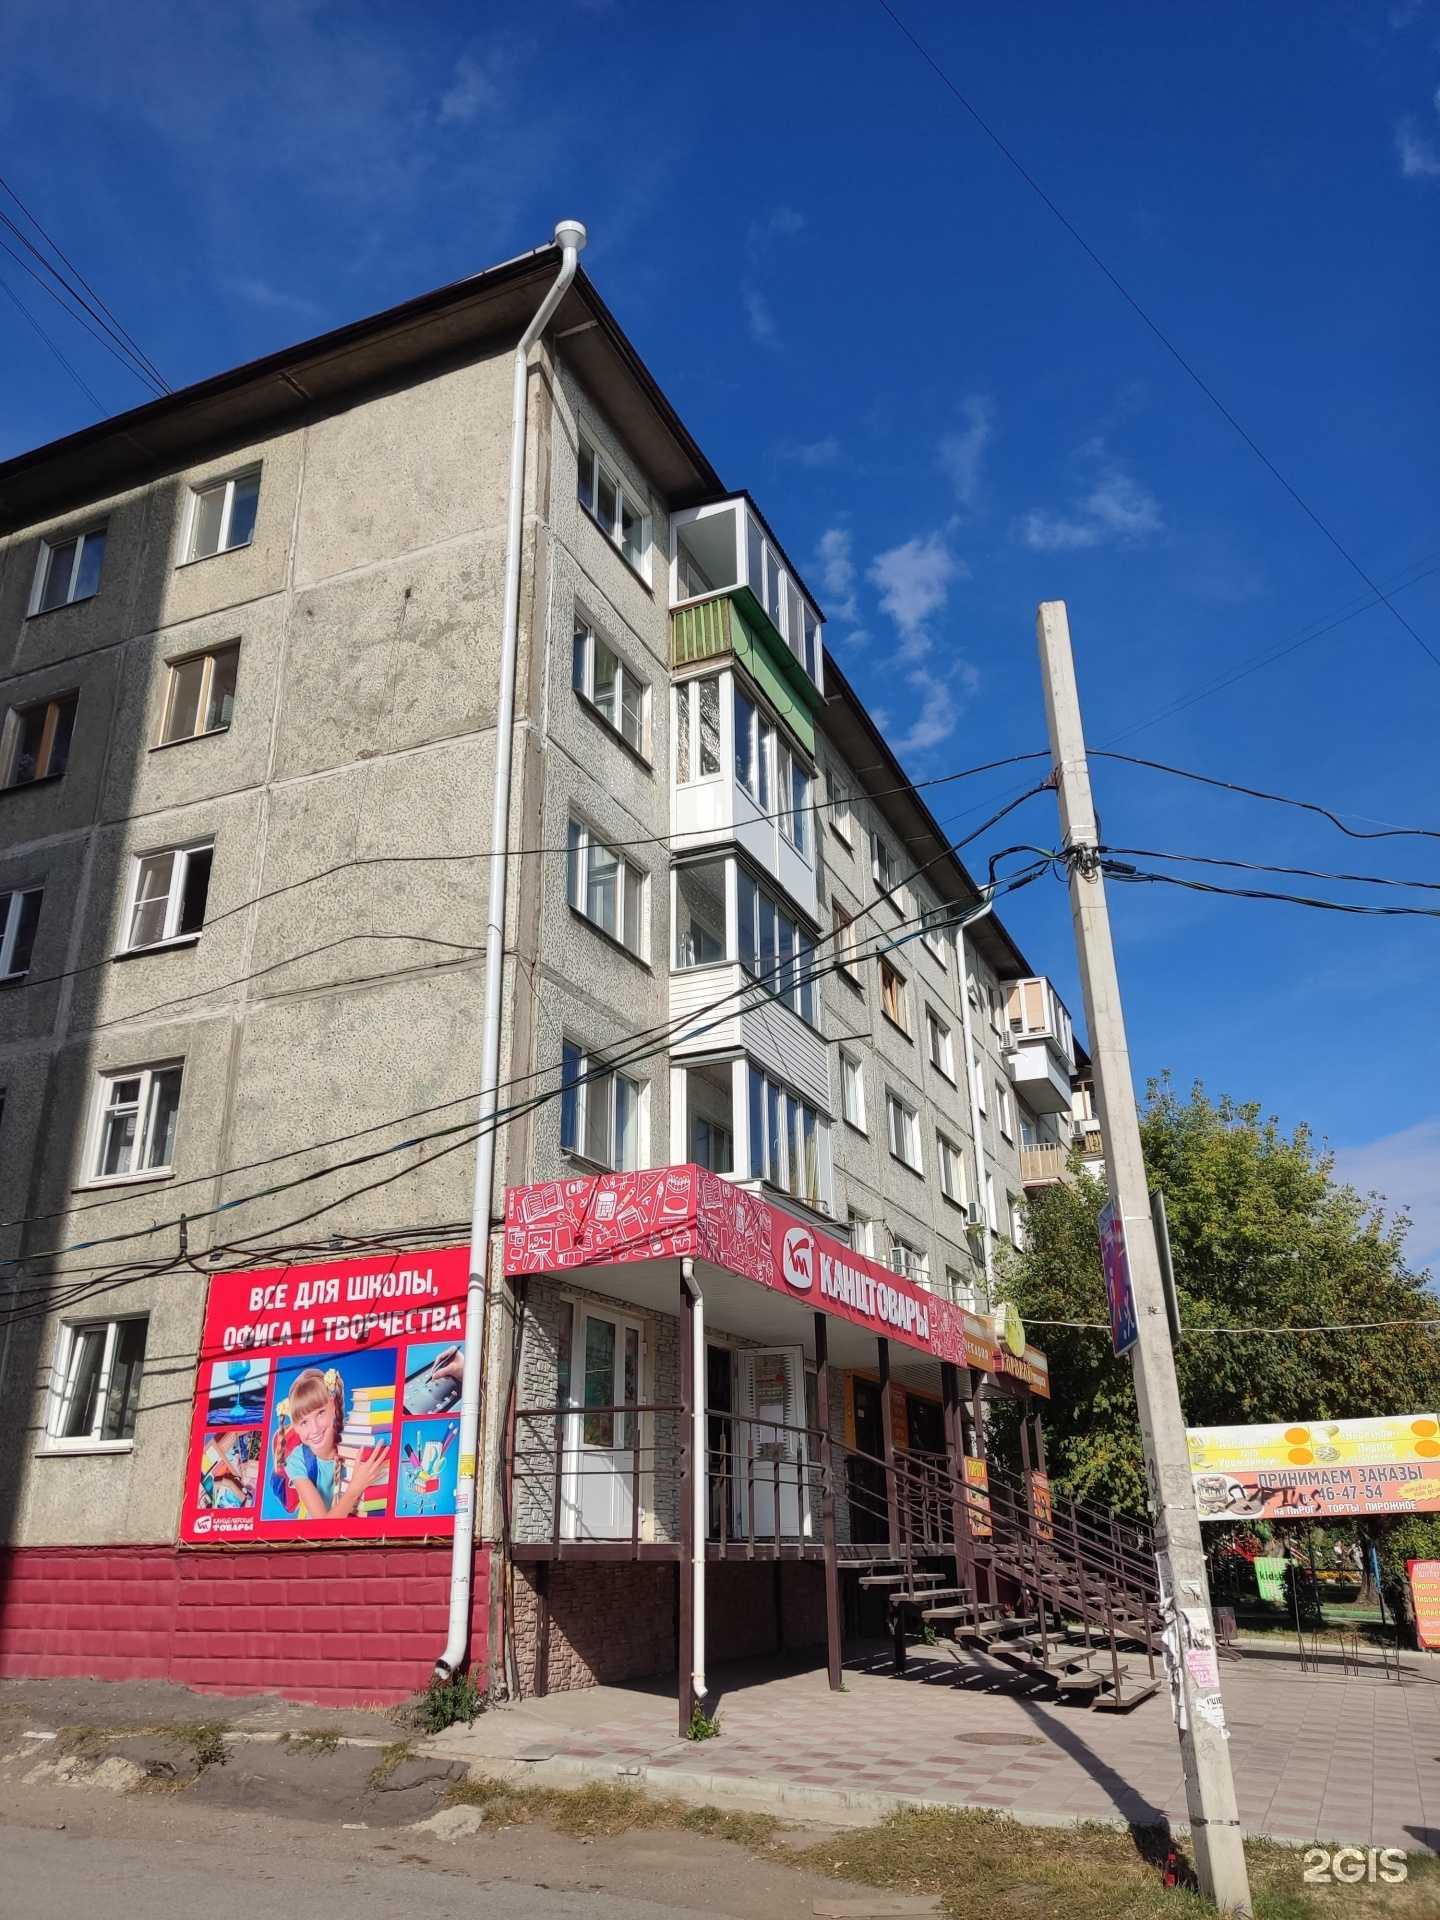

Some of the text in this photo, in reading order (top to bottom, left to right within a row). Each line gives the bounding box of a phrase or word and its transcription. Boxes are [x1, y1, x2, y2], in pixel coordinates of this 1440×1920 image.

[249, 1268, 439, 1312] ВСЕ ДЛЯ ШКОЛЫ,
[820, 1251, 930, 1340] КАНЦТОВАРЫ
[223, 1304, 462, 1352] ОФИСА И ТВОРЧЕСТВА
[1258, 1465, 1423, 1489] ПРИНИМАЕМ ЗАКАЗЫ
[1318, 1484, 1383, 1501] 46-47-54
[1328, 1503, 1361, 1513] ТОРТЫ
[1365, 1500, 1417, 1512] ПИРОЖНОЕ
[213, 1523, 254, 1532] ТОВАРЫ
